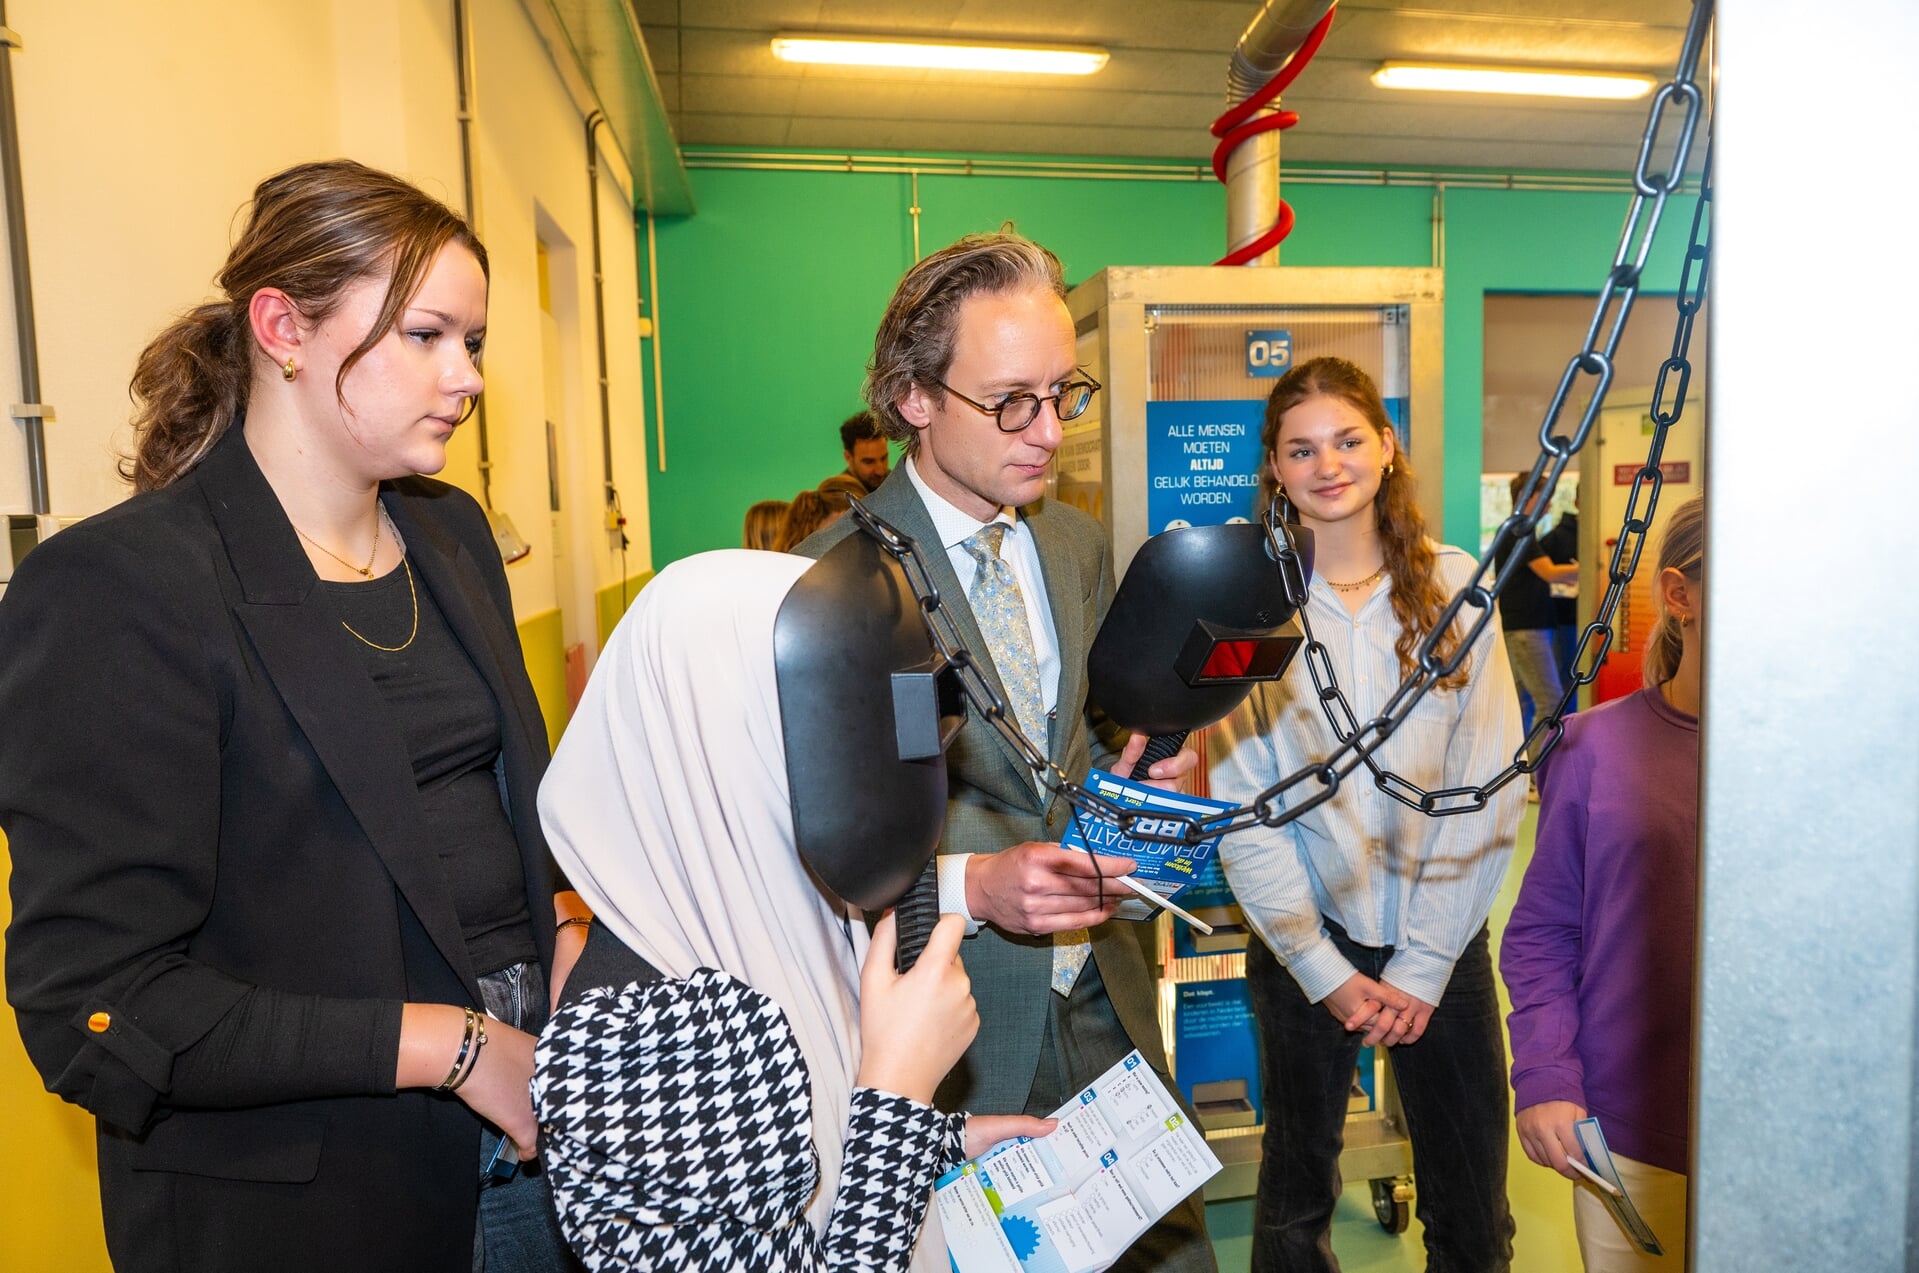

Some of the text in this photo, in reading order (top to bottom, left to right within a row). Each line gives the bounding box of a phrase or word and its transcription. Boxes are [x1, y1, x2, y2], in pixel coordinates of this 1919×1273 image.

[1249, 340, 1289, 367] 05
[1168, 424, 1245, 437] ALLE MENSEN
[1183, 441, 1230, 454] MOETEN
[1190, 458, 1224, 471] ALTIJD
[1154, 475, 1260, 489] GELIJK BEHANDELD
[1180, 492, 1233, 505] WORDEN.
[1099, 789, 1120, 800] Route
[1124, 797, 1143, 807] Start
[1164, 861, 1193, 875] Welkom
[1127, 1057, 1137, 1068] 01
[1083, 1091, 1093, 1102] 03
[1169, 1116, 1179, 1128] 02
[1104, 1152, 1116, 1164] 04
